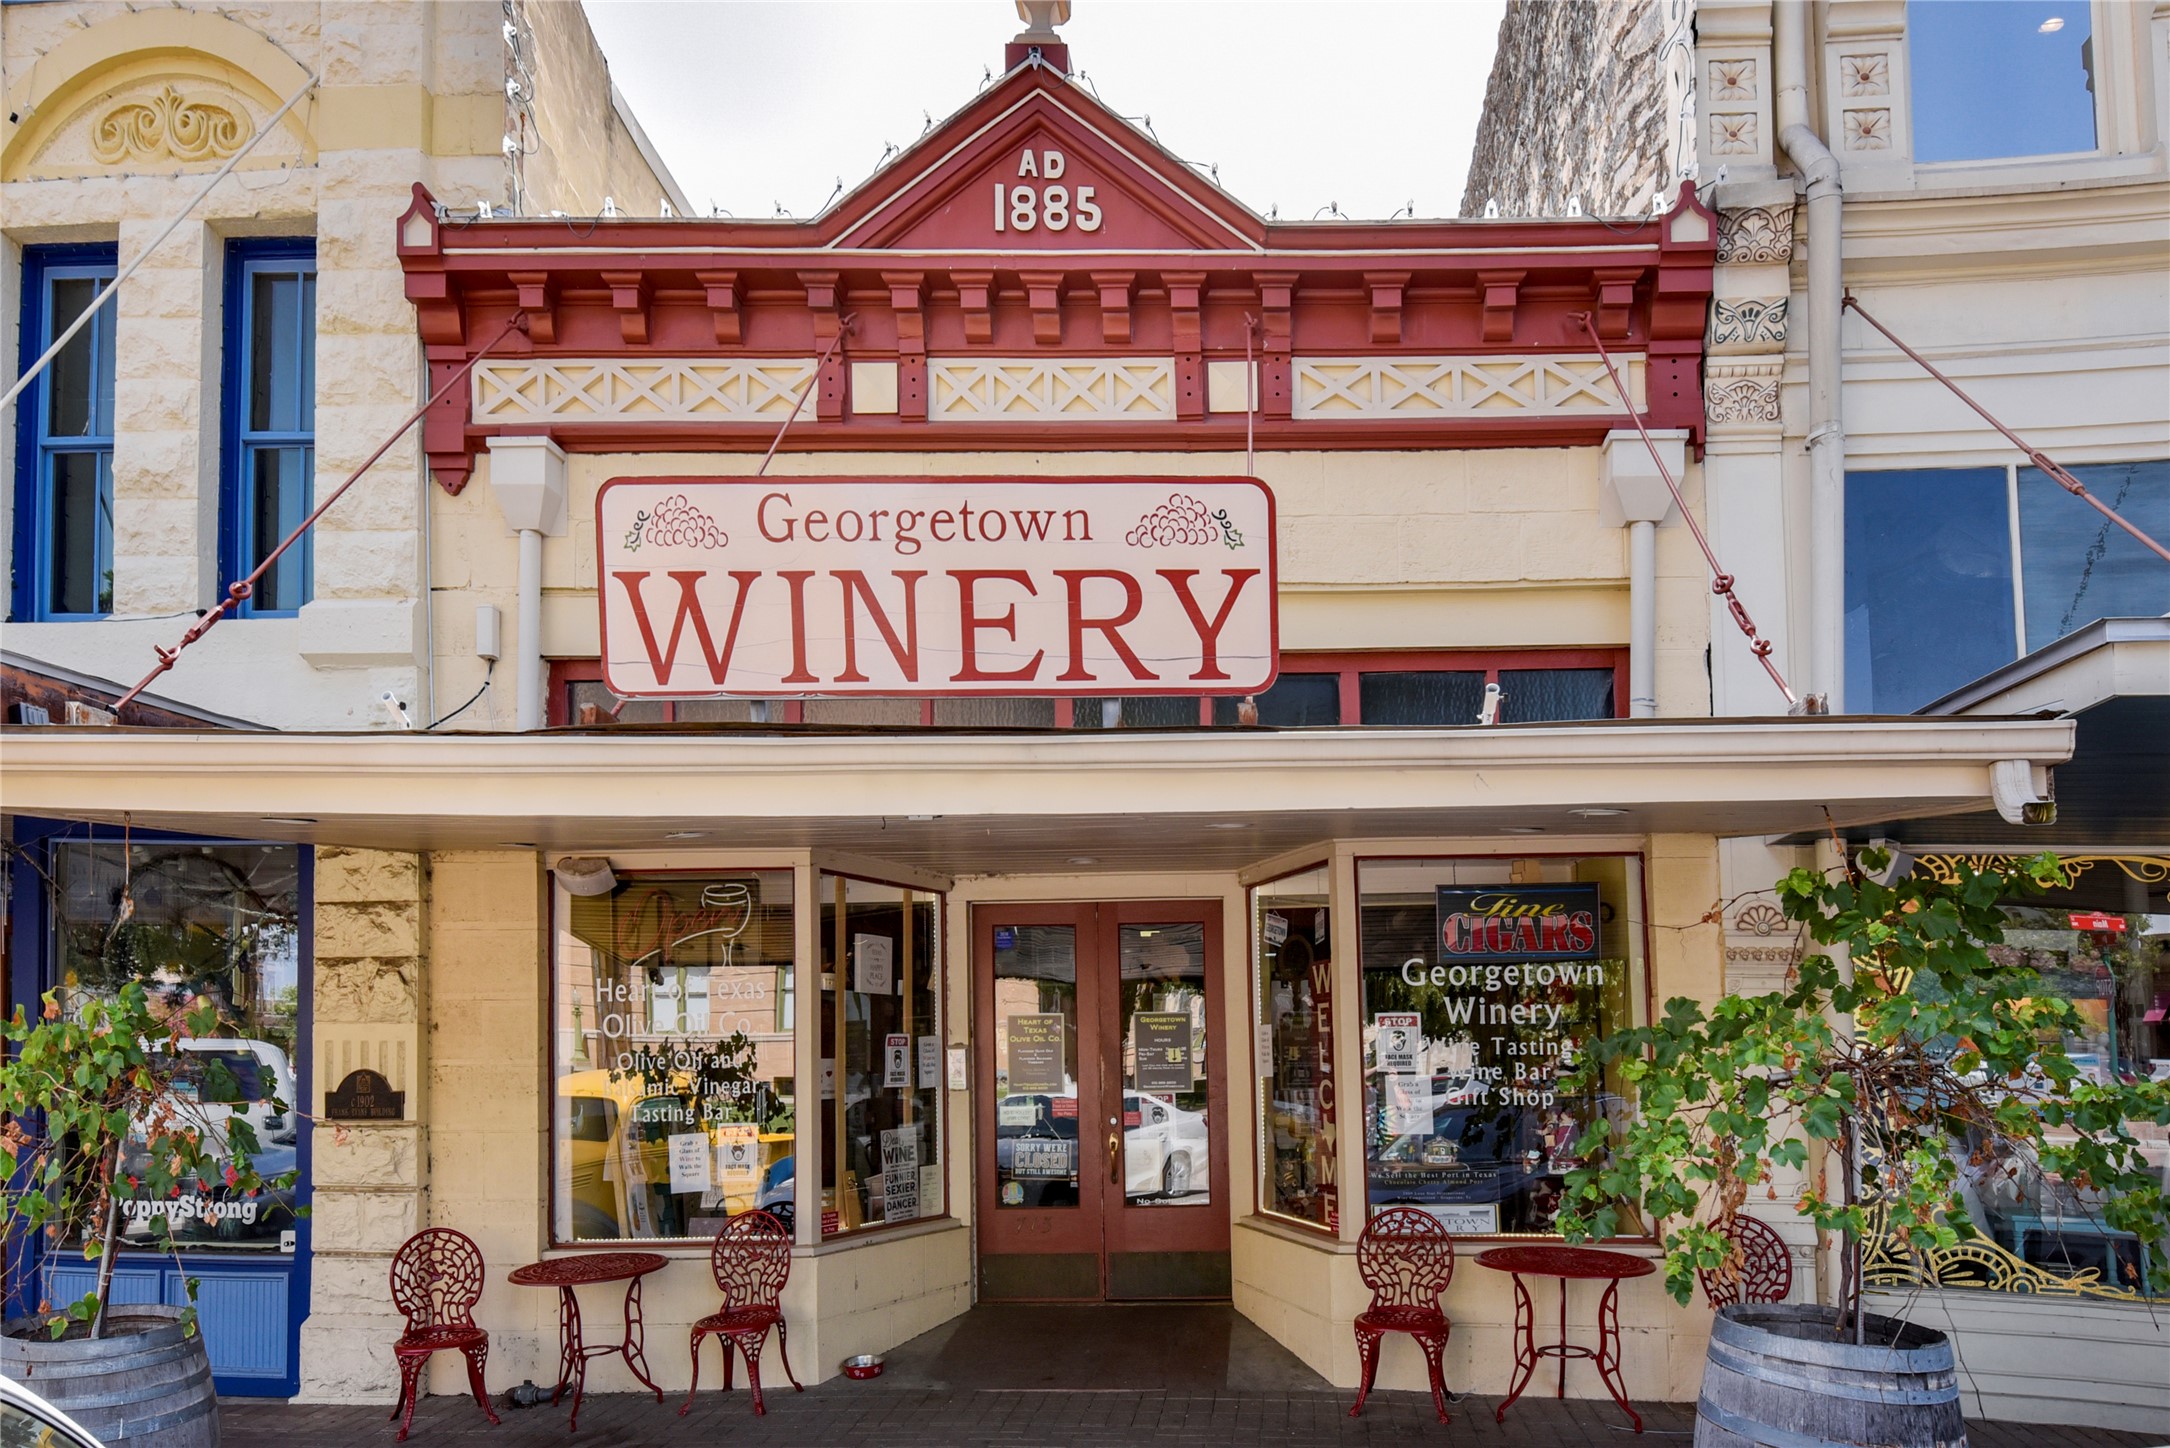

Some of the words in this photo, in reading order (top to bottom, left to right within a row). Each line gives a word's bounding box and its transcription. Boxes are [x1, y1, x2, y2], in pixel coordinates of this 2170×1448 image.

[1018, 149, 1065, 179] AD
[994, 183, 1103, 232] 1885
[757, 493, 1094, 555] Georgetown
[612, 568, 1262, 686] WINERY
[1463, 893, 1566, 918] Fine
[1442, 911, 1596, 954] CIGARS
[595, 976, 657, 1002] Heart
[668, 974, 693, 1001] of
[700, 976, 766, 1000] Texas
[1401, 958, 1604, 992] Georgetown
[602, 1013, 664, 1038] Olive
[674, 1012, 710, 1038] Oil
[1385, 1017, 1412, 1026] STOP
[1443, 996, 1563, 1030] Winery
[890, 1038, 906, 1046] STOP
[1490, 1036, 1572, 1063] Tasting
[617, 1052, 666, 1070] Olive
[674, 1051, 702, 1070] Oil
[710, 1050, 743, 1069] and
[1449, 1063, 1503, 1080] Wine
[1515, 1062, 1551, 1080] Bar
[605, 1078, 679, 1098] Balsamic
[690, 1077, 760, 1097] Vinegar
[1445, 1087, 1489, 1106] Gift
[1500, 1087, 1554, 1109] Shop
[632, 1104, 695, 1125] Tasting
[703, 1104, 733, 1120] Bar
[1015, 1143, 1041, 1152] SORRY
[1015, 1152, 1068, 1169] CLOSED
[117, 1194, 257, 1225] oppyStrong
